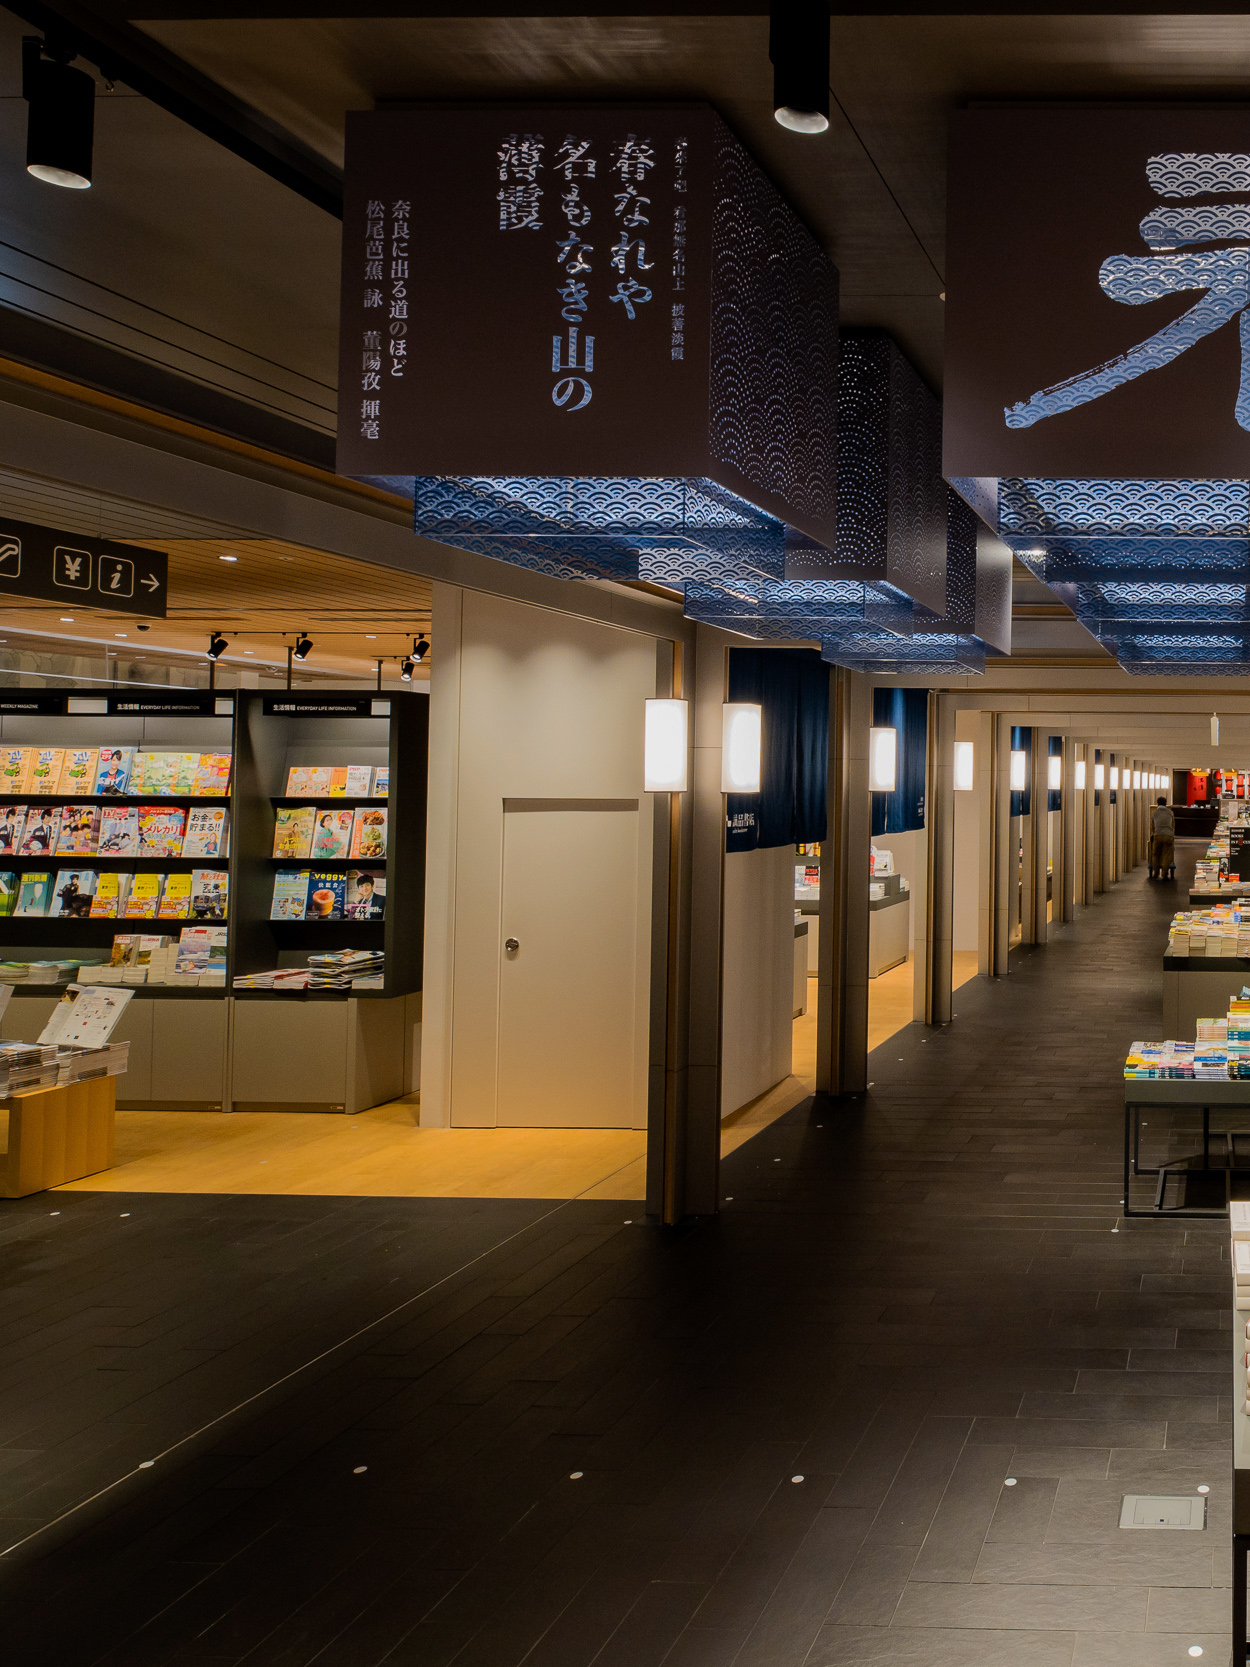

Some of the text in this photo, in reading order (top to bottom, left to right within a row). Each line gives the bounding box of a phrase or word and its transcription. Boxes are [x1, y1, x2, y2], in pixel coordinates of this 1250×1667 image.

[496, 132, 546, 231] 薄霞
[363, 201, 386, 281] 松尾芭蕉
[608, 132, 657, 321] 春なれや
[363, 288, 384, 309] 詠
[388, 200, 412, 377] 奈良に出る道のほど
[551, 132, 598, 412] 名もなき山の
[360, 399, 381, 440] 揮毫
[116, 703, 140, 711] 生活情報
[144, 825, 179, 835] メルカリ
[314, 873, 345, 881] veggy
